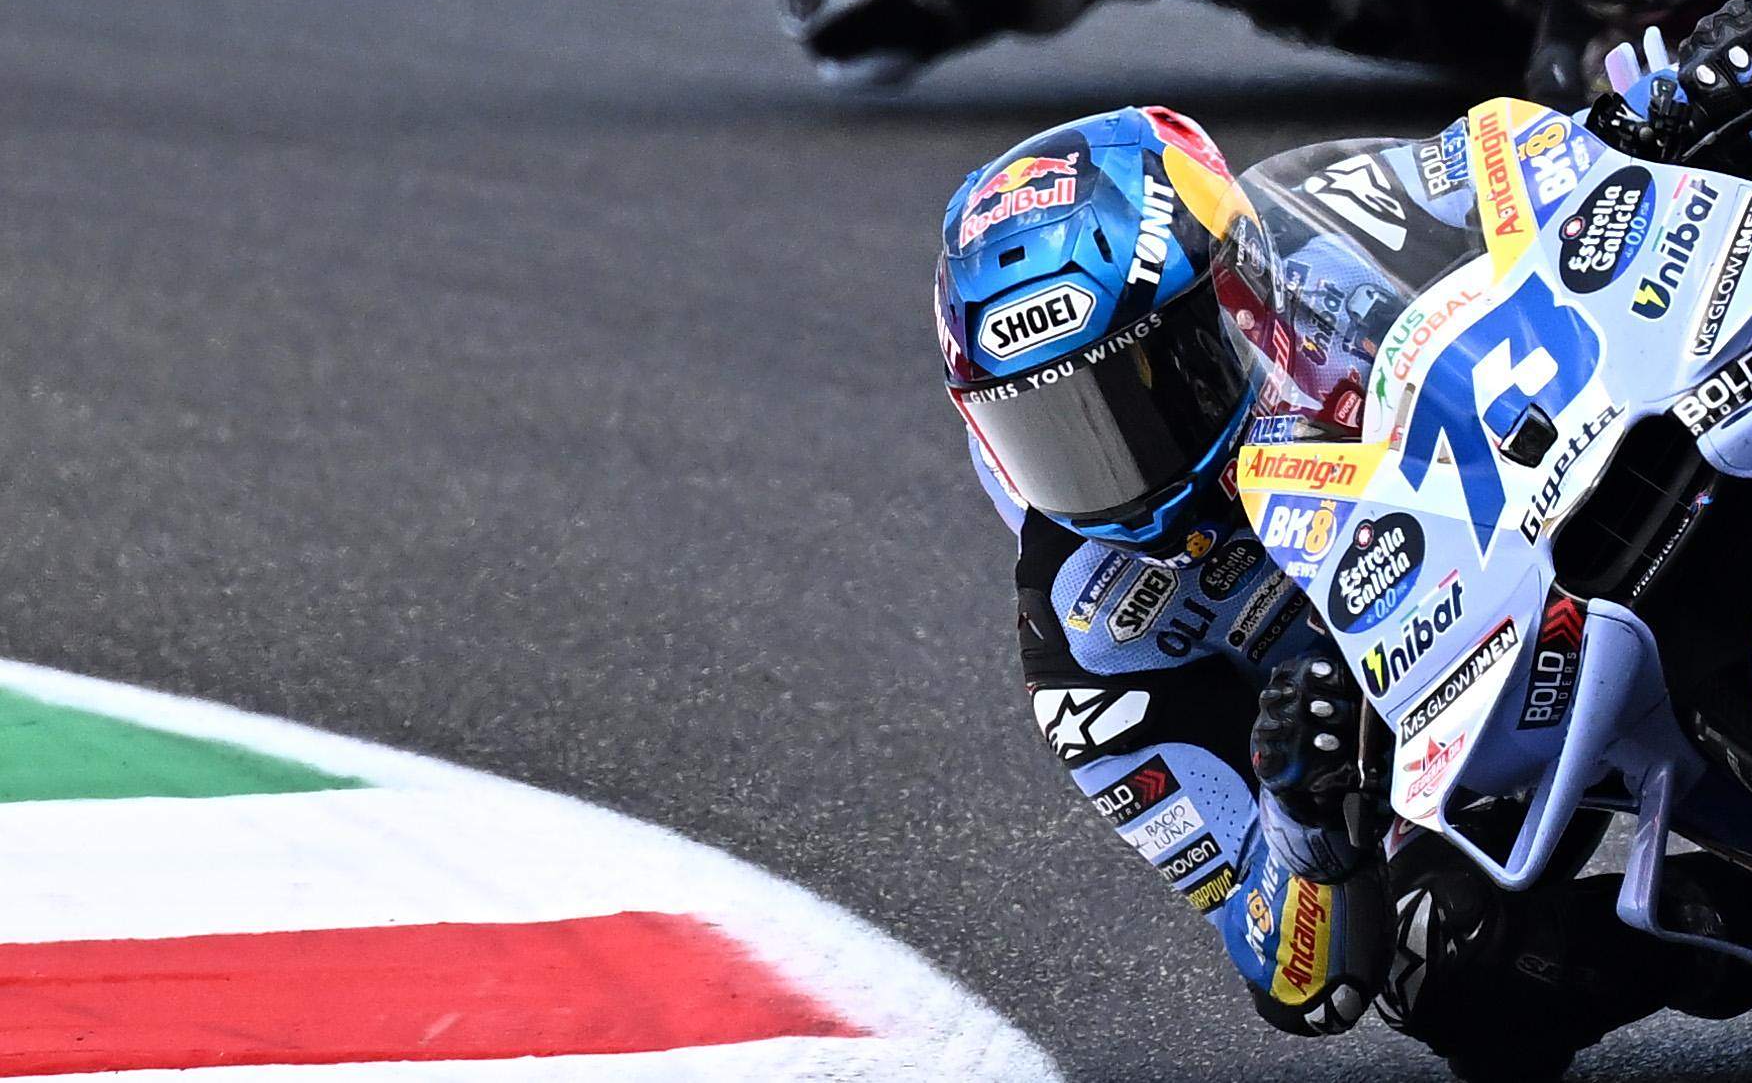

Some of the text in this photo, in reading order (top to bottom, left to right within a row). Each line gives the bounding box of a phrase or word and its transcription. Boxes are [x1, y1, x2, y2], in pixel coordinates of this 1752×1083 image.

[1420, 145, 1450, 196] BOLD
[1479, 111, 1524, 236] Antangin
[1526, 123, 1578, 205] BK8
[1568, 186, 1622, 272] Estrella
[1592, 190, 1641, 271] Galicia
[1632, 178, 1720, 321] Unibat
[990, 293, 1078, 349] SHOEI
[1385, 309, 1428, 365] AUS
[1393, 288, 1484, 381] GLOBAL
[1695, 322, 1718, 355] MS
[1710, 256, 1742, 320] GLOW
[970, 313, 1163, 405] GIVES YOU WINGS
[1399, 272, 1600, 566] 73
[1246, 449, 1357, 489] Antangin
[1265, 504, 1335, 554] BK8
[1339, 526, 1406, 596] Estrella
[1116, 569, 1173, 632] SHOEI
[1286, 561, 1319, 579] NEWS
[1347, 551, 1411, 615] Galicia
[1281, 597, 1306, 622] CLU
[1361, 581, 1464, 698] Unibat
[1402, 711, 1426, 740] MS
[1427, 670, 1470, 717] GLOW
[1525, 651, 1565, 721] BOLD
[1093, 785, 1134, 816] OLD
[1154, 821, 1194, 849] LUNA
